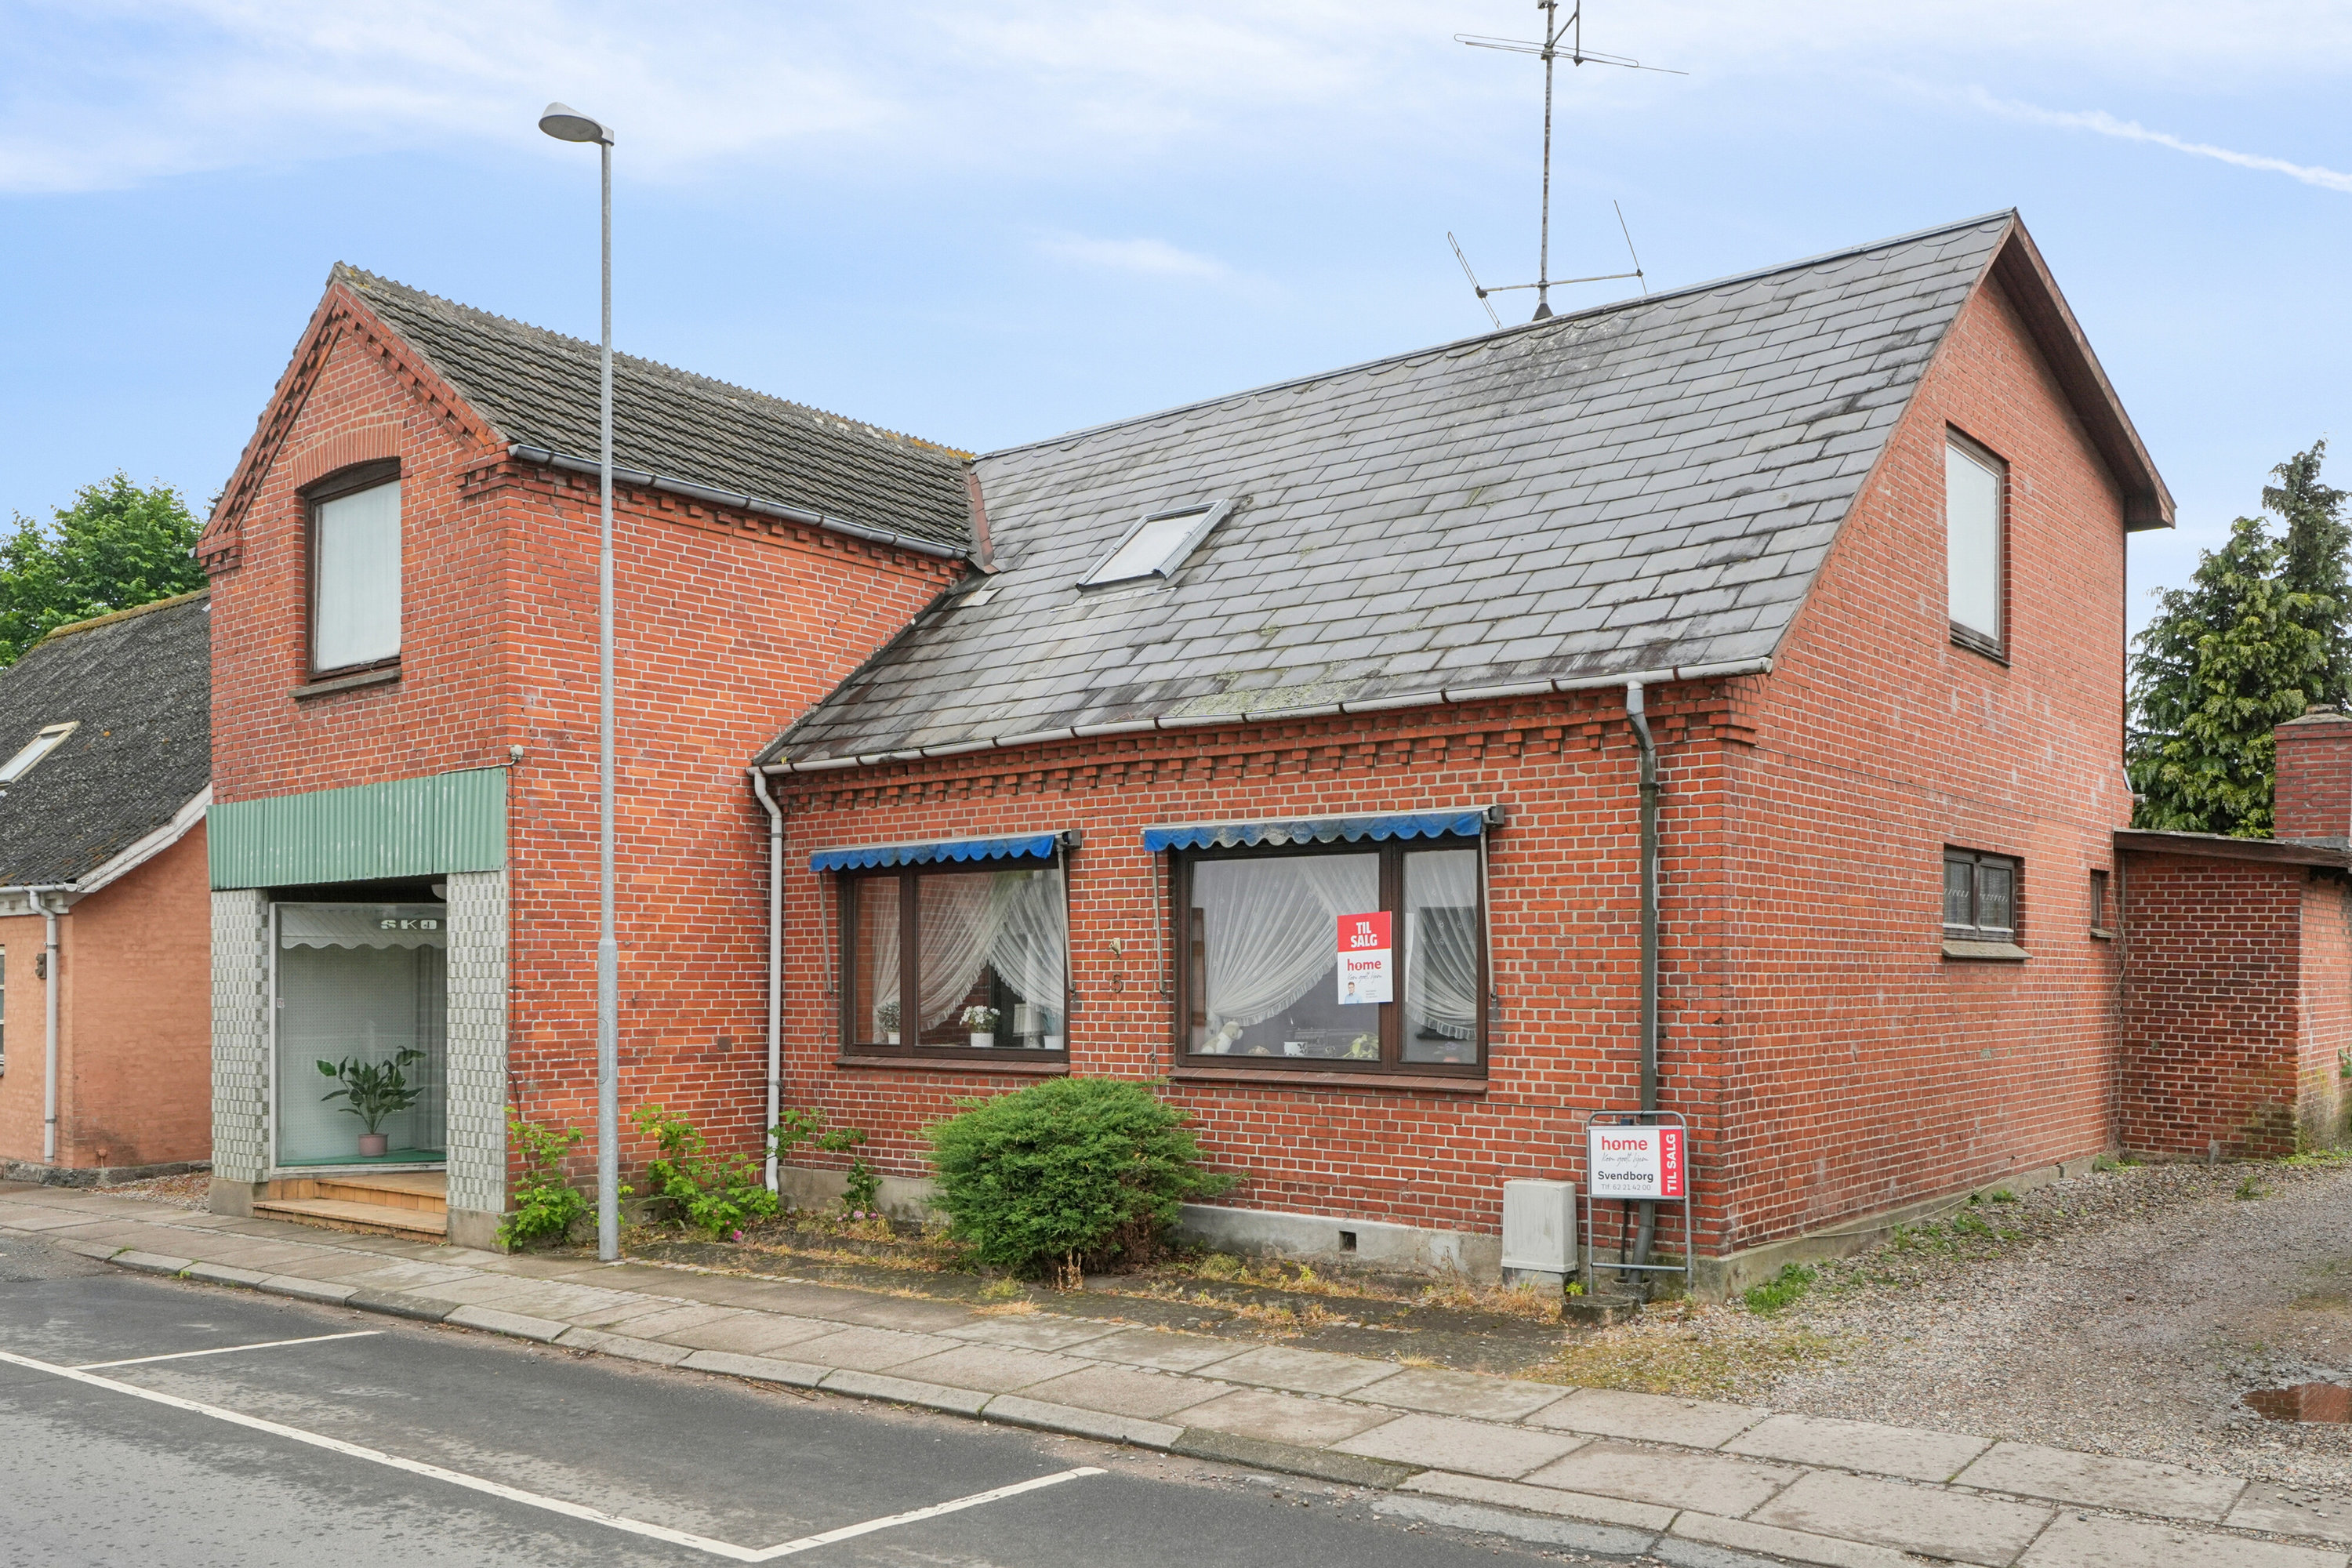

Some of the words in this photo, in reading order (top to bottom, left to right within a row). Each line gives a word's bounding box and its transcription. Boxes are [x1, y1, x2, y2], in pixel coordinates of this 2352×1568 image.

[381, 920, 437, 930] SKO
[1356, 921, 1372, 935] TIL
[1350, 934, 1377, 948] SALG
[1347, 958, 1382, 971] home
[1601, 1136, 1648, 1151] home
[1666, 1134, 1676, 1169] SALG
[1598, 1171, 1653, 1183] Svendborg
[1667, 1171, 1677, 1192] TIL
